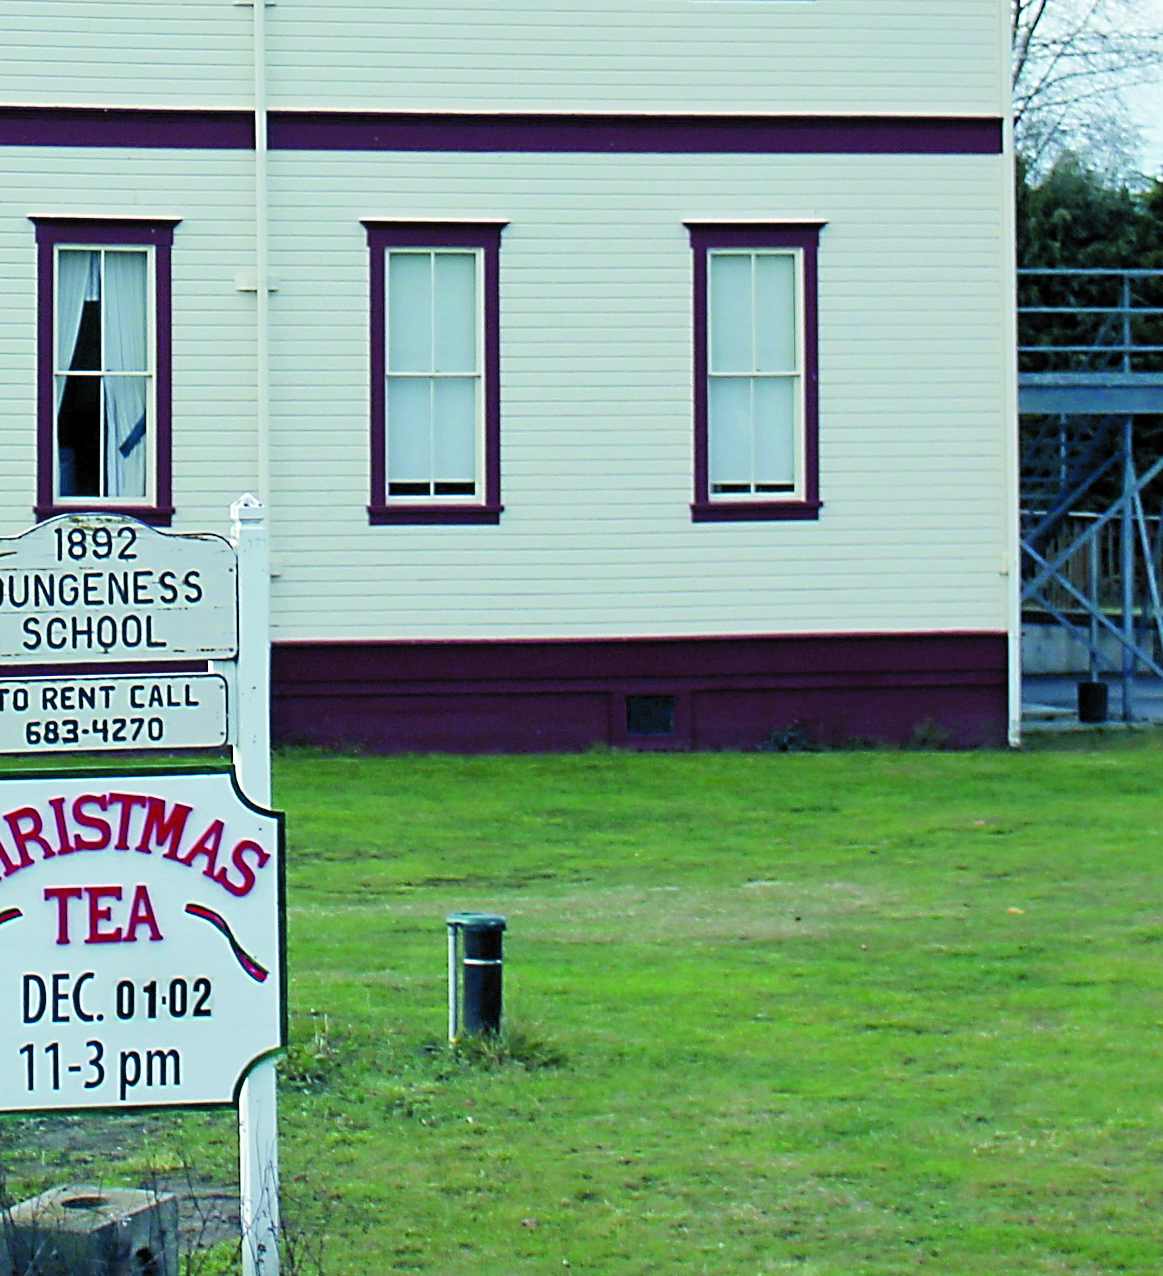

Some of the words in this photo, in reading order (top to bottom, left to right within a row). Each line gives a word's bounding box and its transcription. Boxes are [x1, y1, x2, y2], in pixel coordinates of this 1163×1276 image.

[53, 527, 138, 561] 1892
[22, 615, 167, 650] SCHOOL
[42, 685, 116, 711] RENT
[130, 684, 199, 708] CALL
[26, 717, 164, 745] 683-4270
[43, 885, 164, 945] TEA
[22, 971, 104, 1024] DEC.
[19, 1040, 105, 1091] 11-3
[119, 1047, 181, 1101] pm
